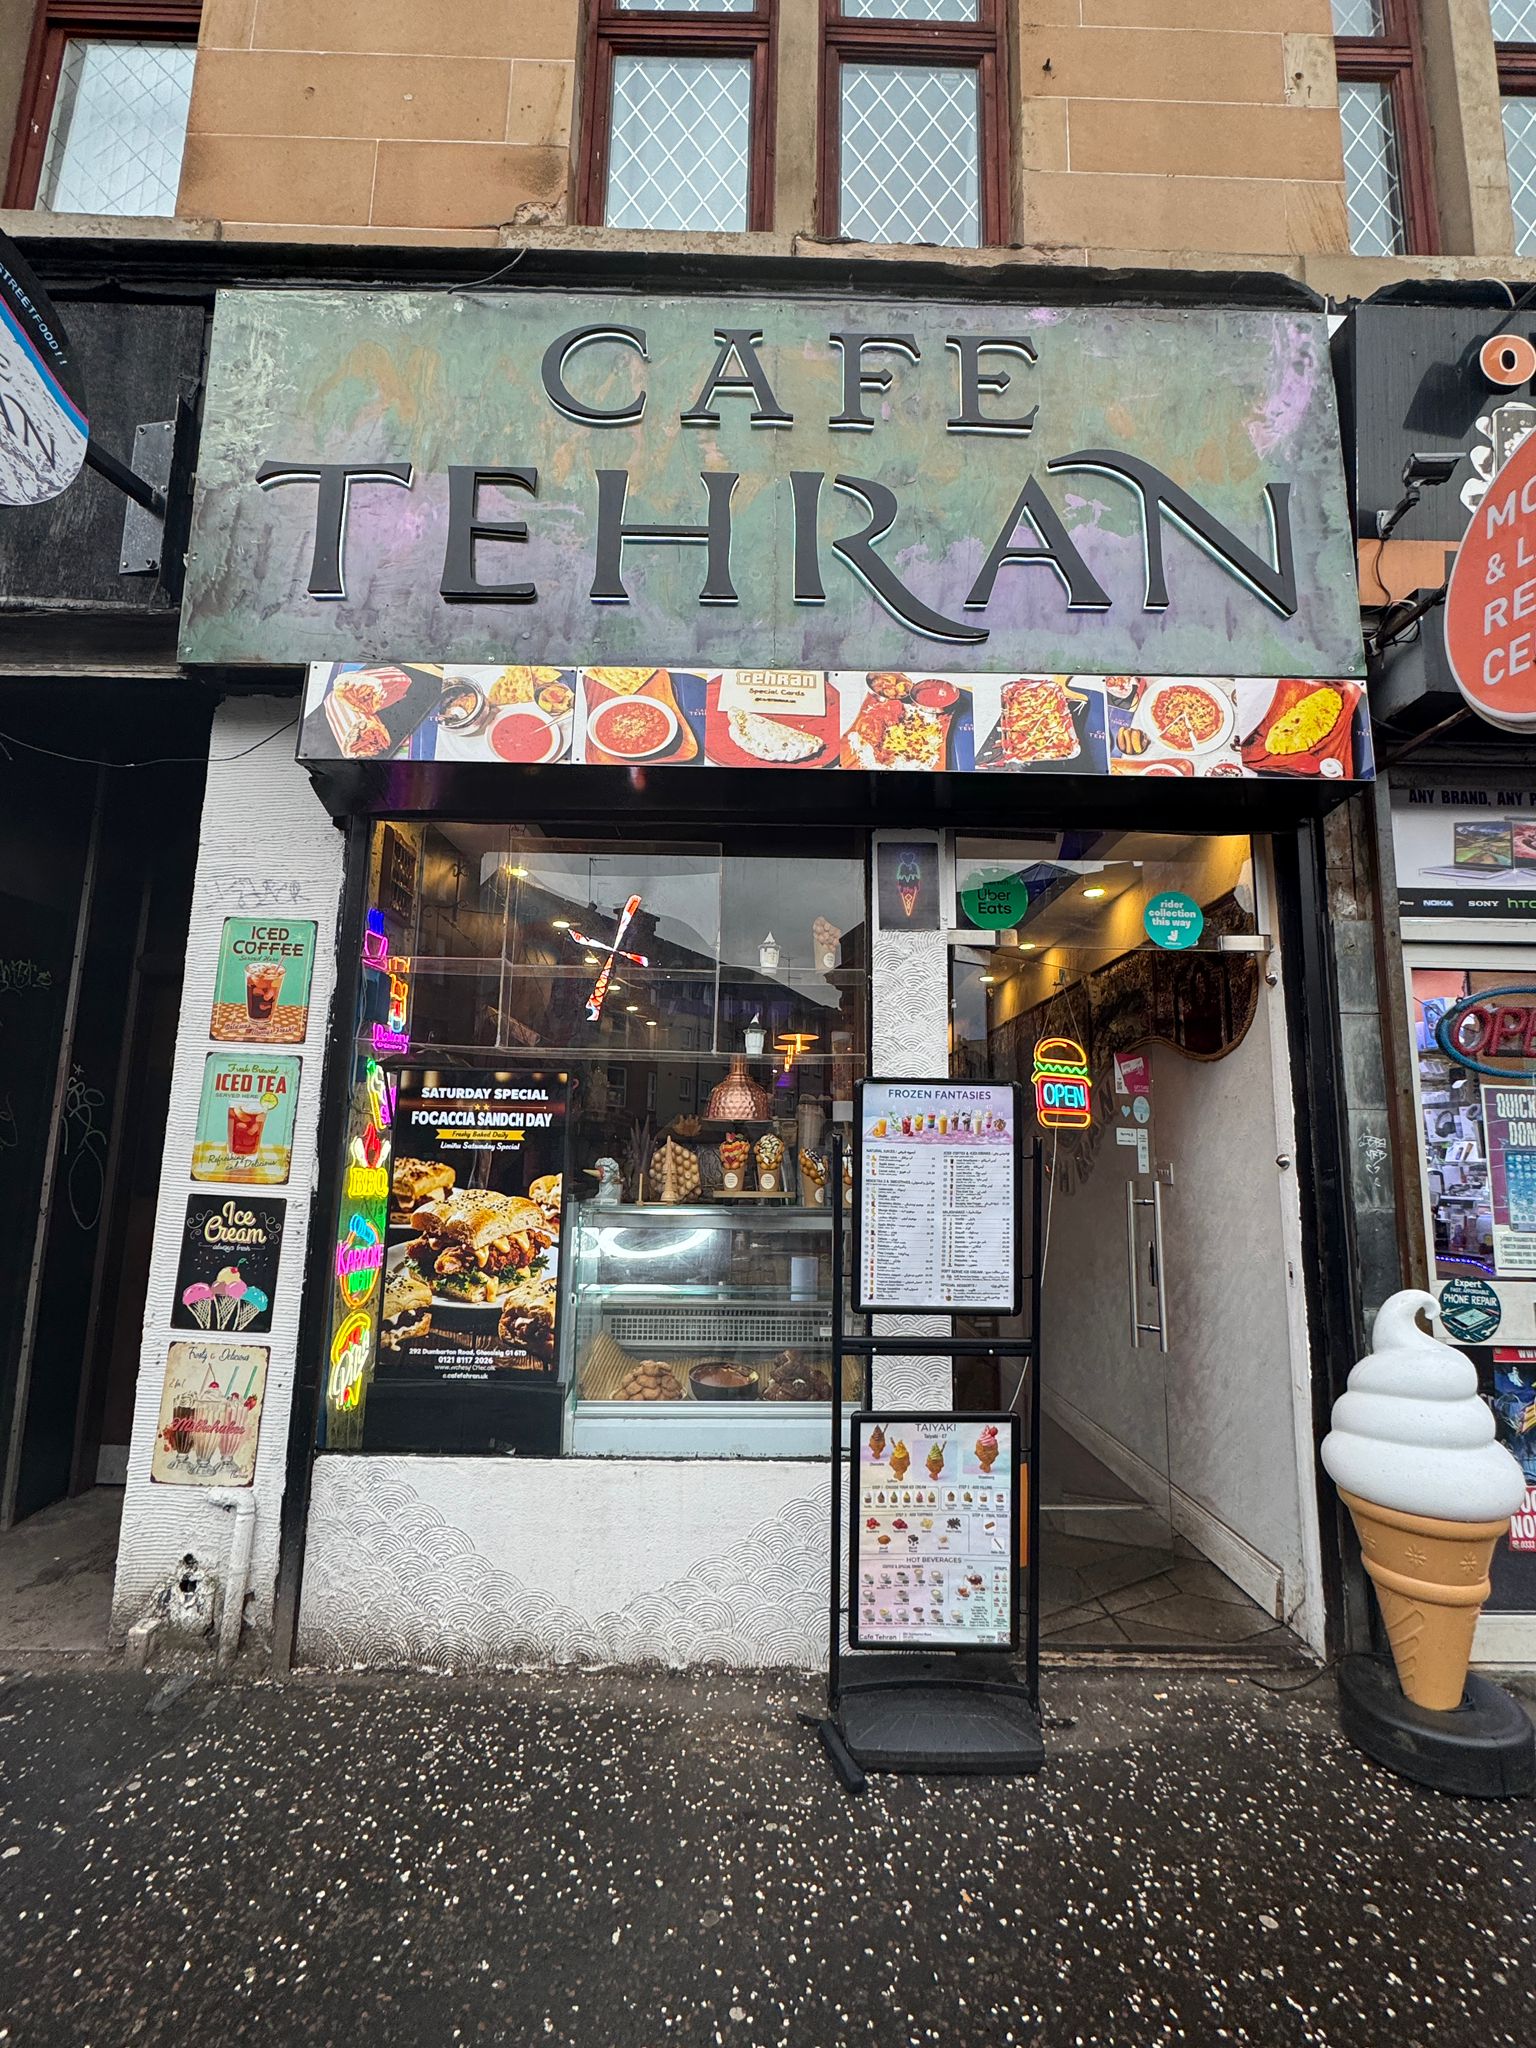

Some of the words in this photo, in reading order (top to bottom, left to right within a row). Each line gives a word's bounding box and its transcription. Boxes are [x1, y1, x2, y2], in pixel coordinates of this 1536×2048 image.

[541, 322, 1040, 436] CAFE
[255, 448, 1298, 645] TEHRAN
[1485, 552, 1506, 585] &
[1409, 789, 1434, 804] ANY
[1441, 790, 1491, 806] BRAND,
[1497, 791, 1522, 806] ANY
[977, 889, 1011, 901] Uber
[978, 902, 1012, 914] Eats
[1160, 899, 1184, 908] rider
[1148, 909, 1197, 918] collection
[1152, 917, 1170, 926] this
[1172, 919, 1191, 929] way
[251, 926, 290, 941] ICED
[233, 940, 305, 957] COFFEE
[228, 1063, 250, 1073] Fresh
[215, 1073, 253, 1092] ICED
[257, 1075, 287, 1093] TEA
[421, 1087, 492, 1100] SATURDAY
[494, 1088, 549, 1101] SPECIAL
[888, 1089, 932, 1099] FROZEN
[935, 1090, 991, 1100] FANTASIES
[1043, 1083, 1086, 1108] OPEN
[411, 1111, 475, 1126] FOCACCIA
[477, 1112, 524, 1127] SANDCH
[525, 1113, 553, 1128] DAY
[496, 1142, 520, 1152] Special
[350, 1167, 389, 1199] BBQ
[222, 1200, 256, 1226] Ice
[204, 1215, 267, 1244] Cream
[336, 1240, 384, 1277] KARAOKE
[1454, 1278, 1482, 1290] Expert
[1443, 1293, 1470, 1304] PHONE
[1471, 1295, 1498, 1307] REPAIR
[422, 1348, 457, 1356] Dumbarton
[438, 1356, 455, 1364] 0121
[915, 1423, 957, 1432] TAIYAKI
[1511, 1514, 1536, 1538] NO
[875, 1633, 897, 1641] Tehran
